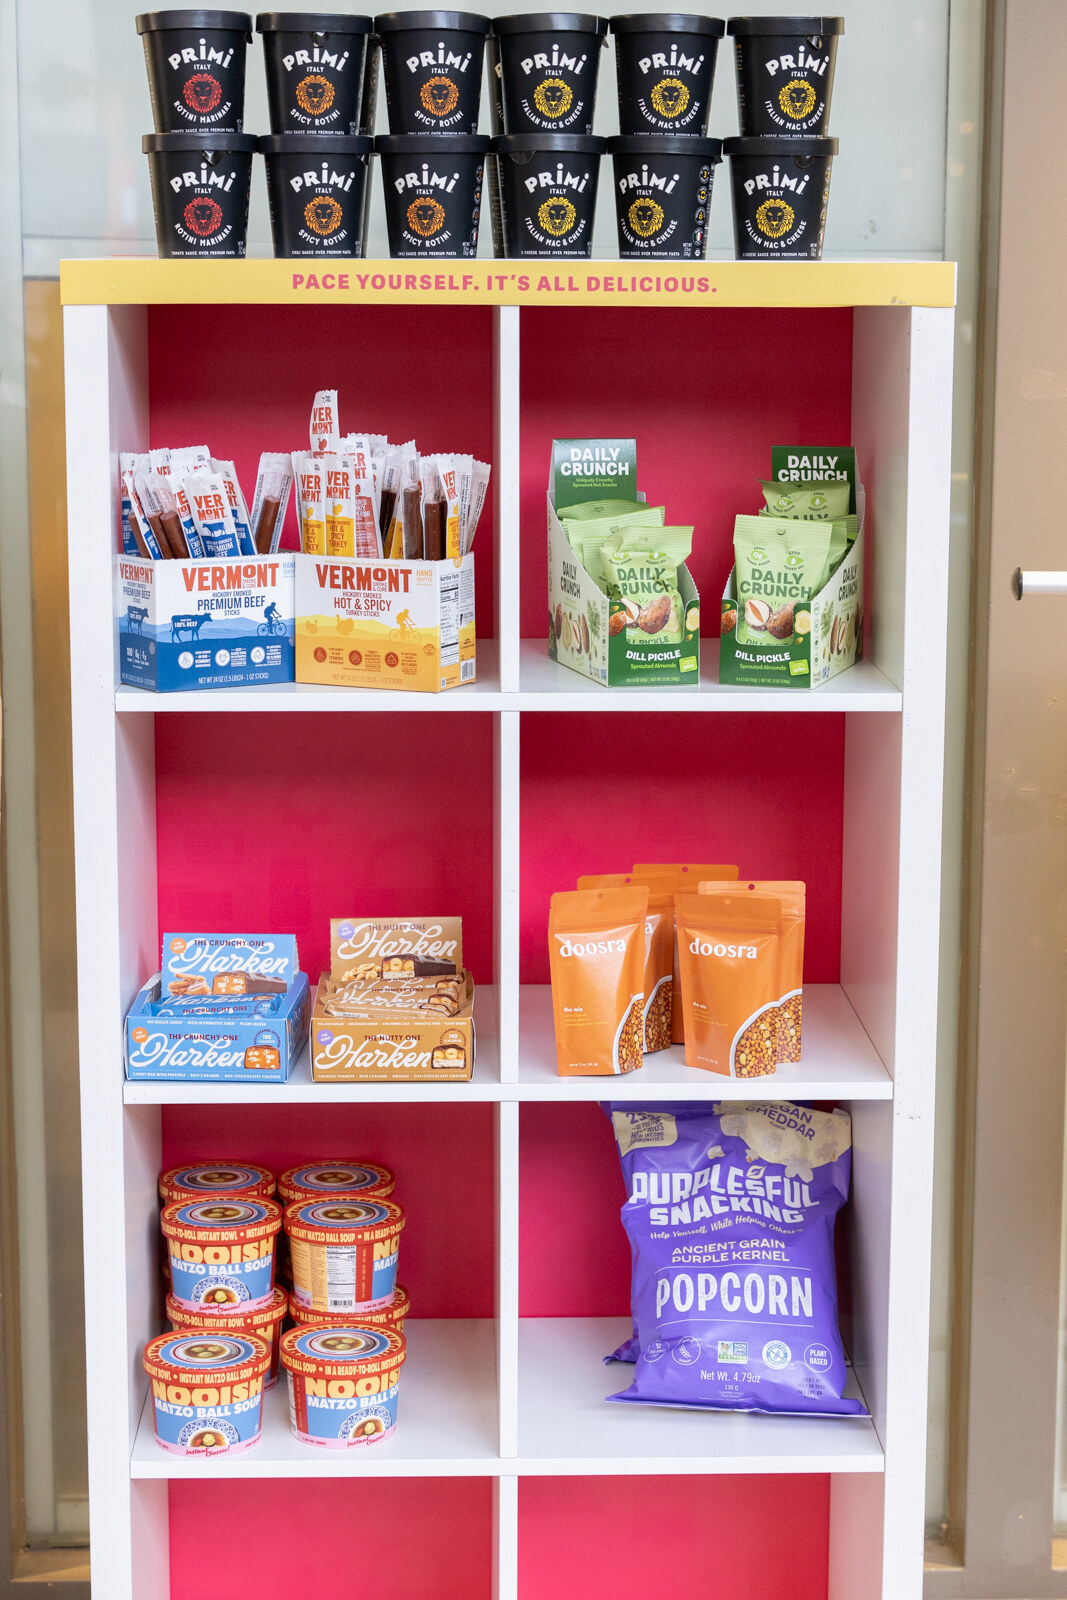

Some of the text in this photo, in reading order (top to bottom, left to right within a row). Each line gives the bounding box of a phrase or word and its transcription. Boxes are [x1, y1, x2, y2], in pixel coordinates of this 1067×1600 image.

[791, 70, 808, 78] ITALY
[173, 100, 232, 123] ROTINI MARINARA
[290, 109, 341, 126] SPICY ROTINI
[174, 223, 233, 247] ROTINI MARINARA
[402, 230, 452, 247] SPICY ROTINI
[620, 218, 678, 248] ITALIAN MAC & CHEESE
[744, 219, 807, 249] ITALIAN MAC & CHEESE
[292, 274, 350, 290] PACE
[356, 274, 479, 291] YOURSELF.
[536, 276, 580, 292] ALL
[586, 276, 718, 293] DELICIOUS.
[313, 407, 333, 421] VER
[570, 448, 620, 461] DAILY
[788, 455, 839, 469] DAILY
[560, 462, 629, 476] CRUNCH
[778, 469, 848, 482] CRUNCH
[327, 471, 349, 487] VER
[193, 494, 224, 509] VER
[329, 524, 340, 533] HOT
[119, 563, 153, 584] VERMONT
[182, 563, 279, 592] VERMONT
[316, 564, 412, 593] VERMONT
[416, 569, 433, 577] HAND
[617, 568, 666, 582] DAILY
[751, 568, 804, 585] DAILY
[123, 587, 151, 599] PREMIUM BEEF
[212, 589, 251, 598] HICKORY SMOKED
[740, 581, 812, 599] CRUNCH
[197, 596, 266, 611] PREMIUM BEEF
[334, 597, 392, 611] HOT & SPICY
[186, 620, 198, 628] BEEF
[626, 650, 681, 661] DILL PICKLE
[735, 650, 791, 662] DILL PICKLE
[337, 923, 457, 960] Harken
[559, 939, 627, 957] doosra
[689, 938, 757, 959] doosra
[168, 938, 289, 974] Harken
[129, 1032, 244, 1068] Harken
[314, 1034, 432, 1069] Harken
[745, 1107, 815, 1140] CHEDDAR
[650, 1195, 804, 1226] SNACKING
[650, 1232, 671, 1240] Help
[711, 1219, 733, 1231] While
[735, 1215, 766, 1228] Helping
[169, 1236, 274, 1265] NOOISH
[672, 1238, 785, 1255] ANCIENT GRAIN
[171, 1255, 273, 1275] MATZO BALL SOUP
[672, 1250, 790, 1264] PURPLE KERNEL
[656, 1272, 813, 1319] POPCORN
[809, 1349, 827, 1358] PLANT
[809, 1357, 828, 1366] BASED
[180, 1367, 253, 1384] INSTANT MATZO BALL SOUP
[700, 1370, 761, 1384] Net Wt. 4.79oz
[152, 1376, 263, 1407] NOOISH
[154, 1394, 261, 1418] MATZO BALL SOUP
[307, 1394, 388, 1410] MATZO BALL
